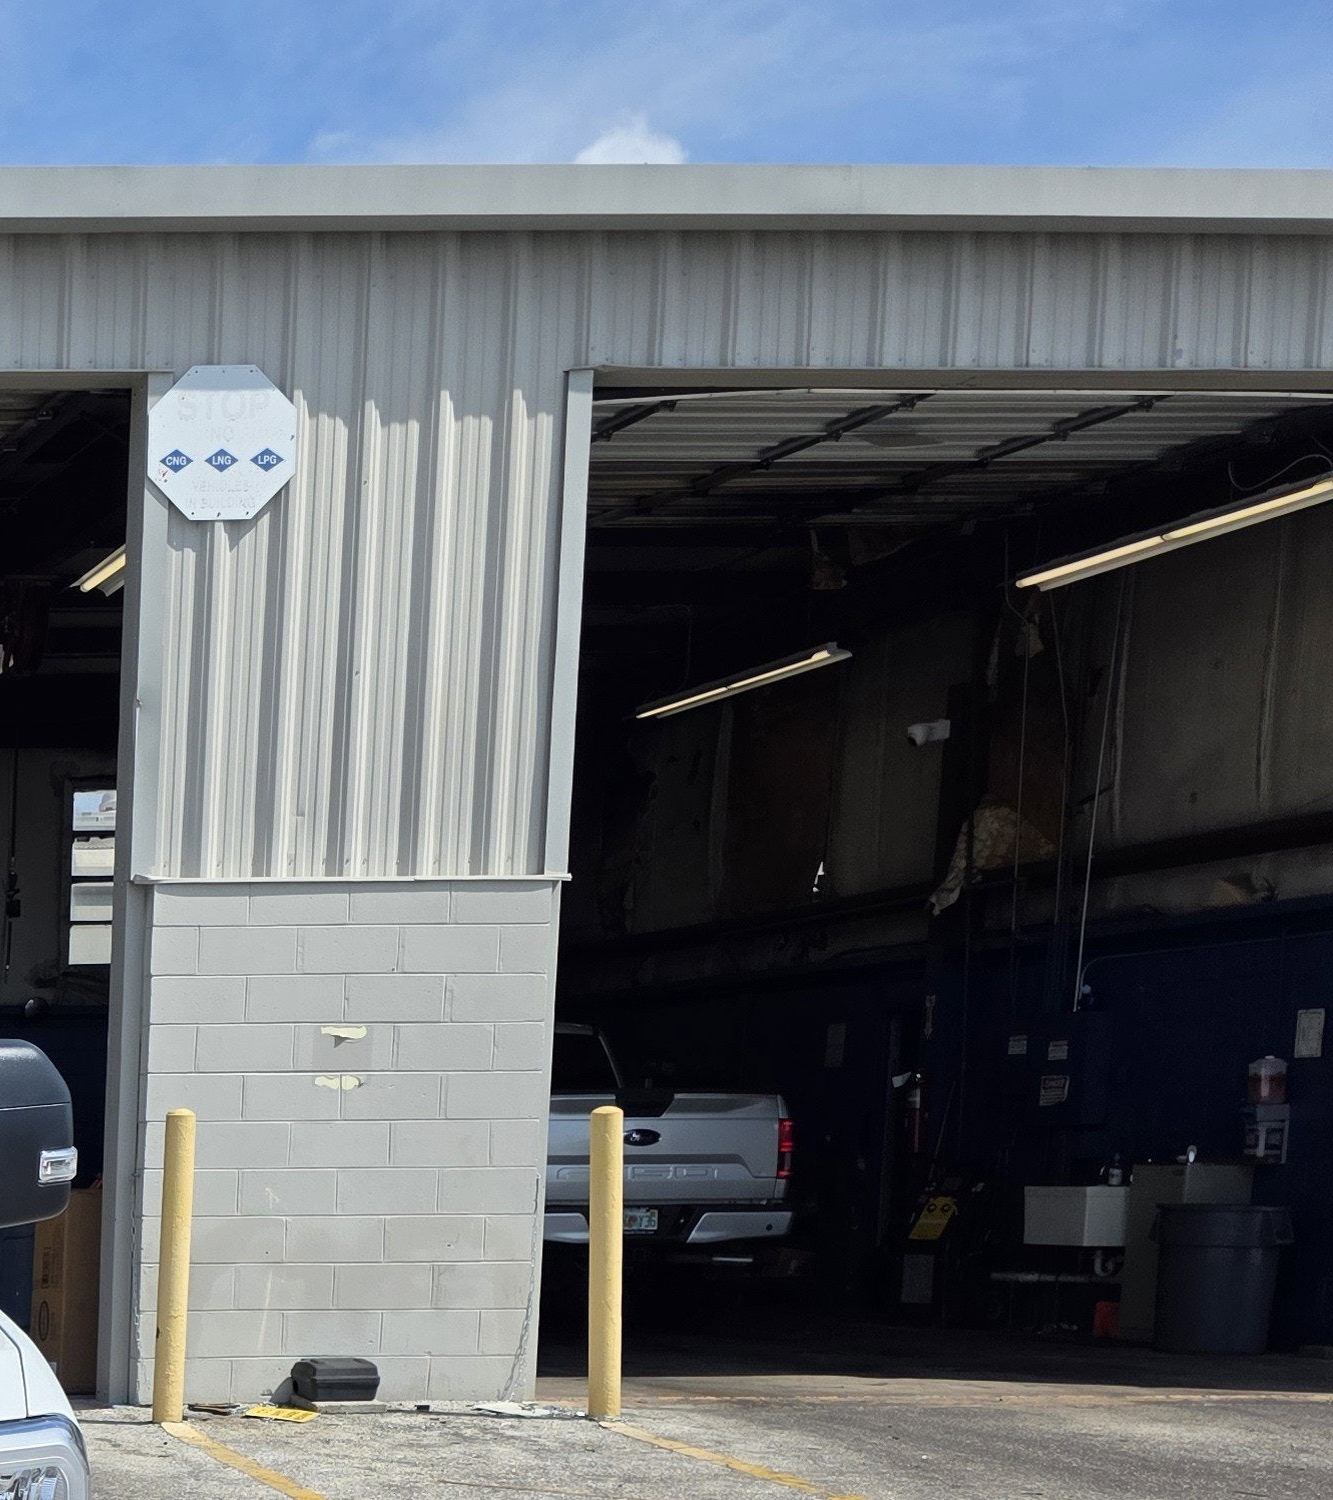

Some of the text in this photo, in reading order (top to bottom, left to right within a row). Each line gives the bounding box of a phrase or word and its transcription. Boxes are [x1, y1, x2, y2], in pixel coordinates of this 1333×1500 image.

[166, 455, 277, 466] CNG LNG LPG
